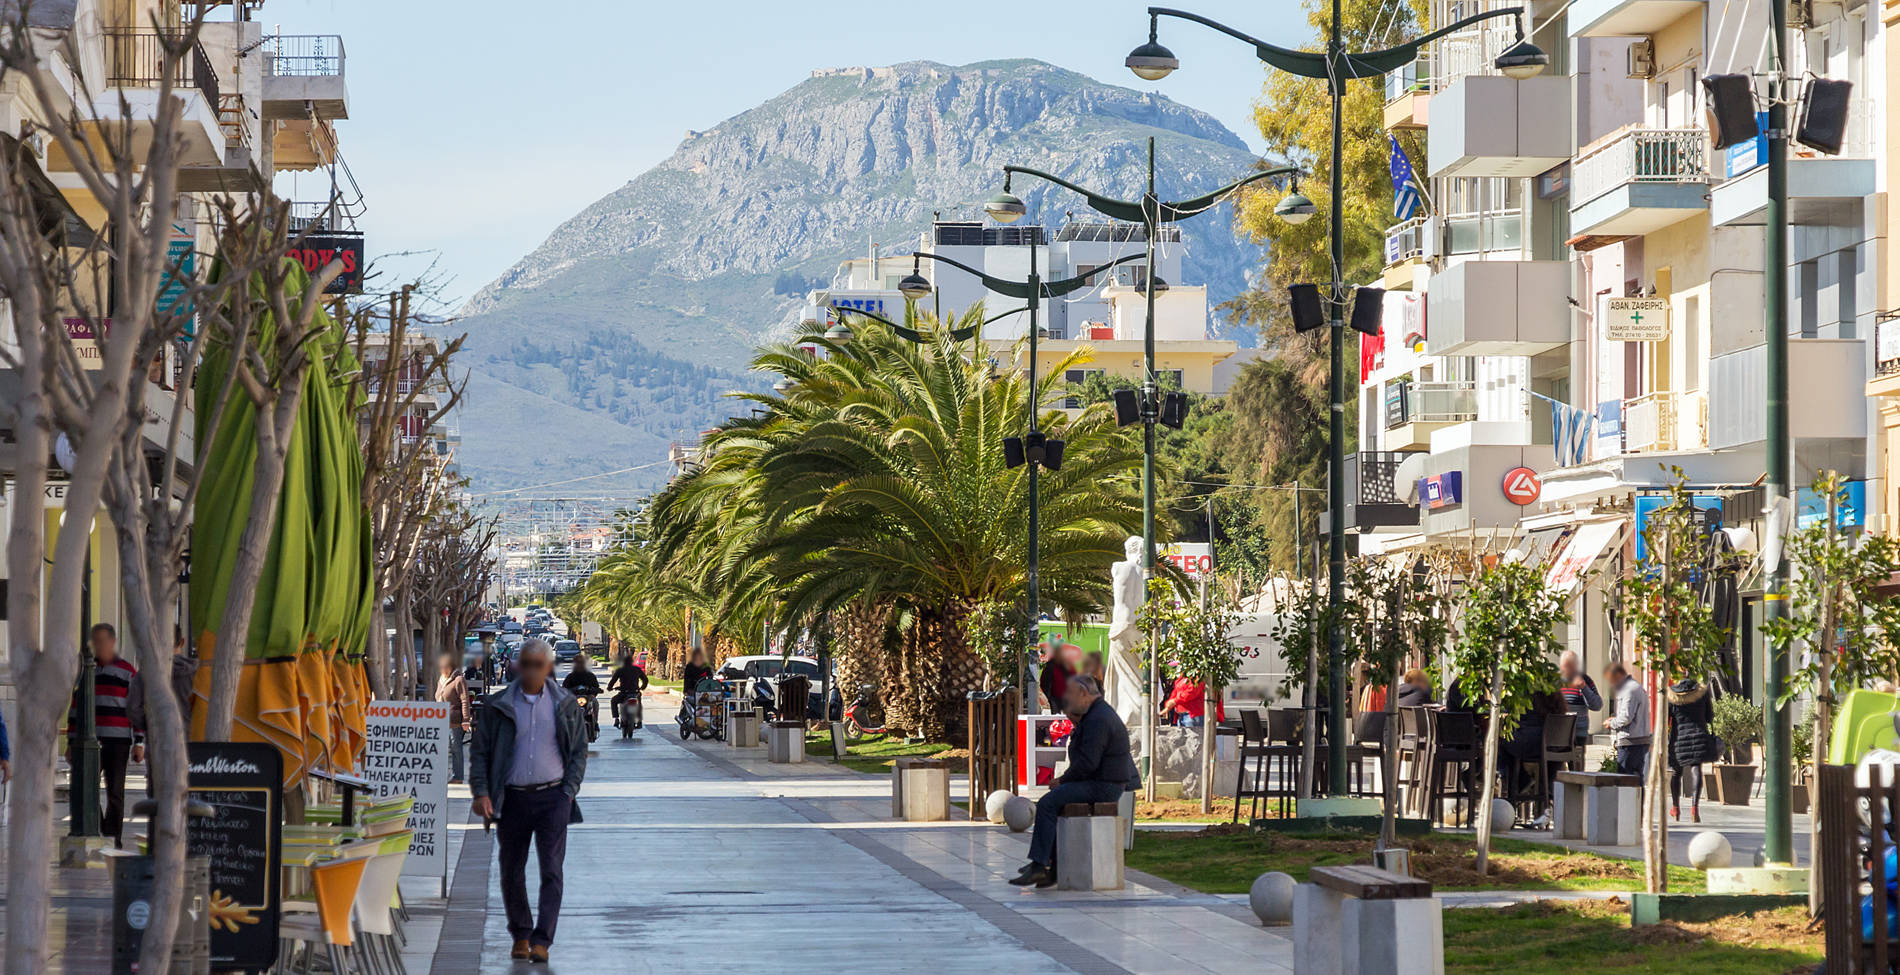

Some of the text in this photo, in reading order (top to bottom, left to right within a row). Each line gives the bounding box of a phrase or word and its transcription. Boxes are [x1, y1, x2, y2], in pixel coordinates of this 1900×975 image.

[1631, 301, 1664, 311] ΖΑΦΕΙΡΗΣ
[1166, 555, 1212, 573] ΤΕΟ
[366, 724, 440, 740] ΕΦΗΜΕΡΙΔΕΣ
[366, 740, 439, 755] ΠΕΡΙΟΔΙΚΑ
[366, 755, 433, 770] ΤΣΙΓΑΡΑ
[364, 770, 432, 784] ΤΗΛΕΚΑΡΤΕΣ
[412, 802, 436, 814] ΕΙΟΥ
